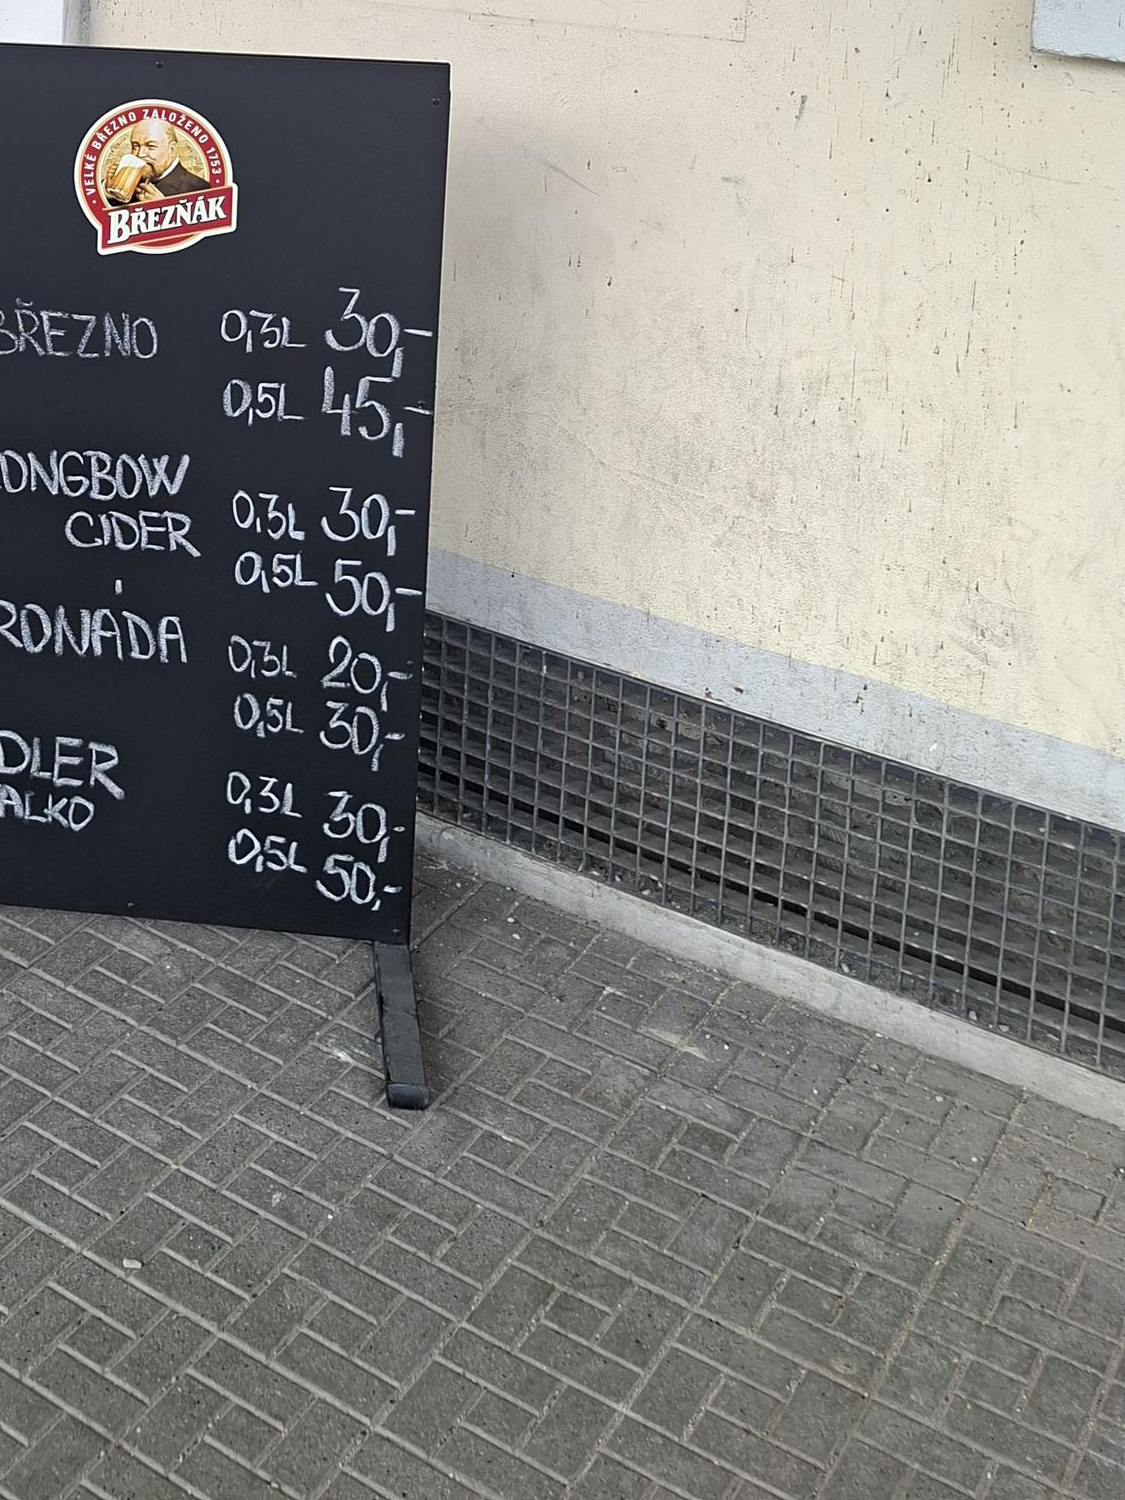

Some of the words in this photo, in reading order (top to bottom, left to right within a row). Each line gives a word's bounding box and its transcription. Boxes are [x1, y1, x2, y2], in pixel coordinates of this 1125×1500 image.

[84, 154, 97, 195] VELKÉ
[91, 112, 137, 150] BŘEZNO
[142, 109, 208, 144] ZALOŽENO
[206, 147, 222, 175] 1753
[107, 196, 227, 245] BŘEZŇÁK
[65, 511, 201, 557] CIDER
